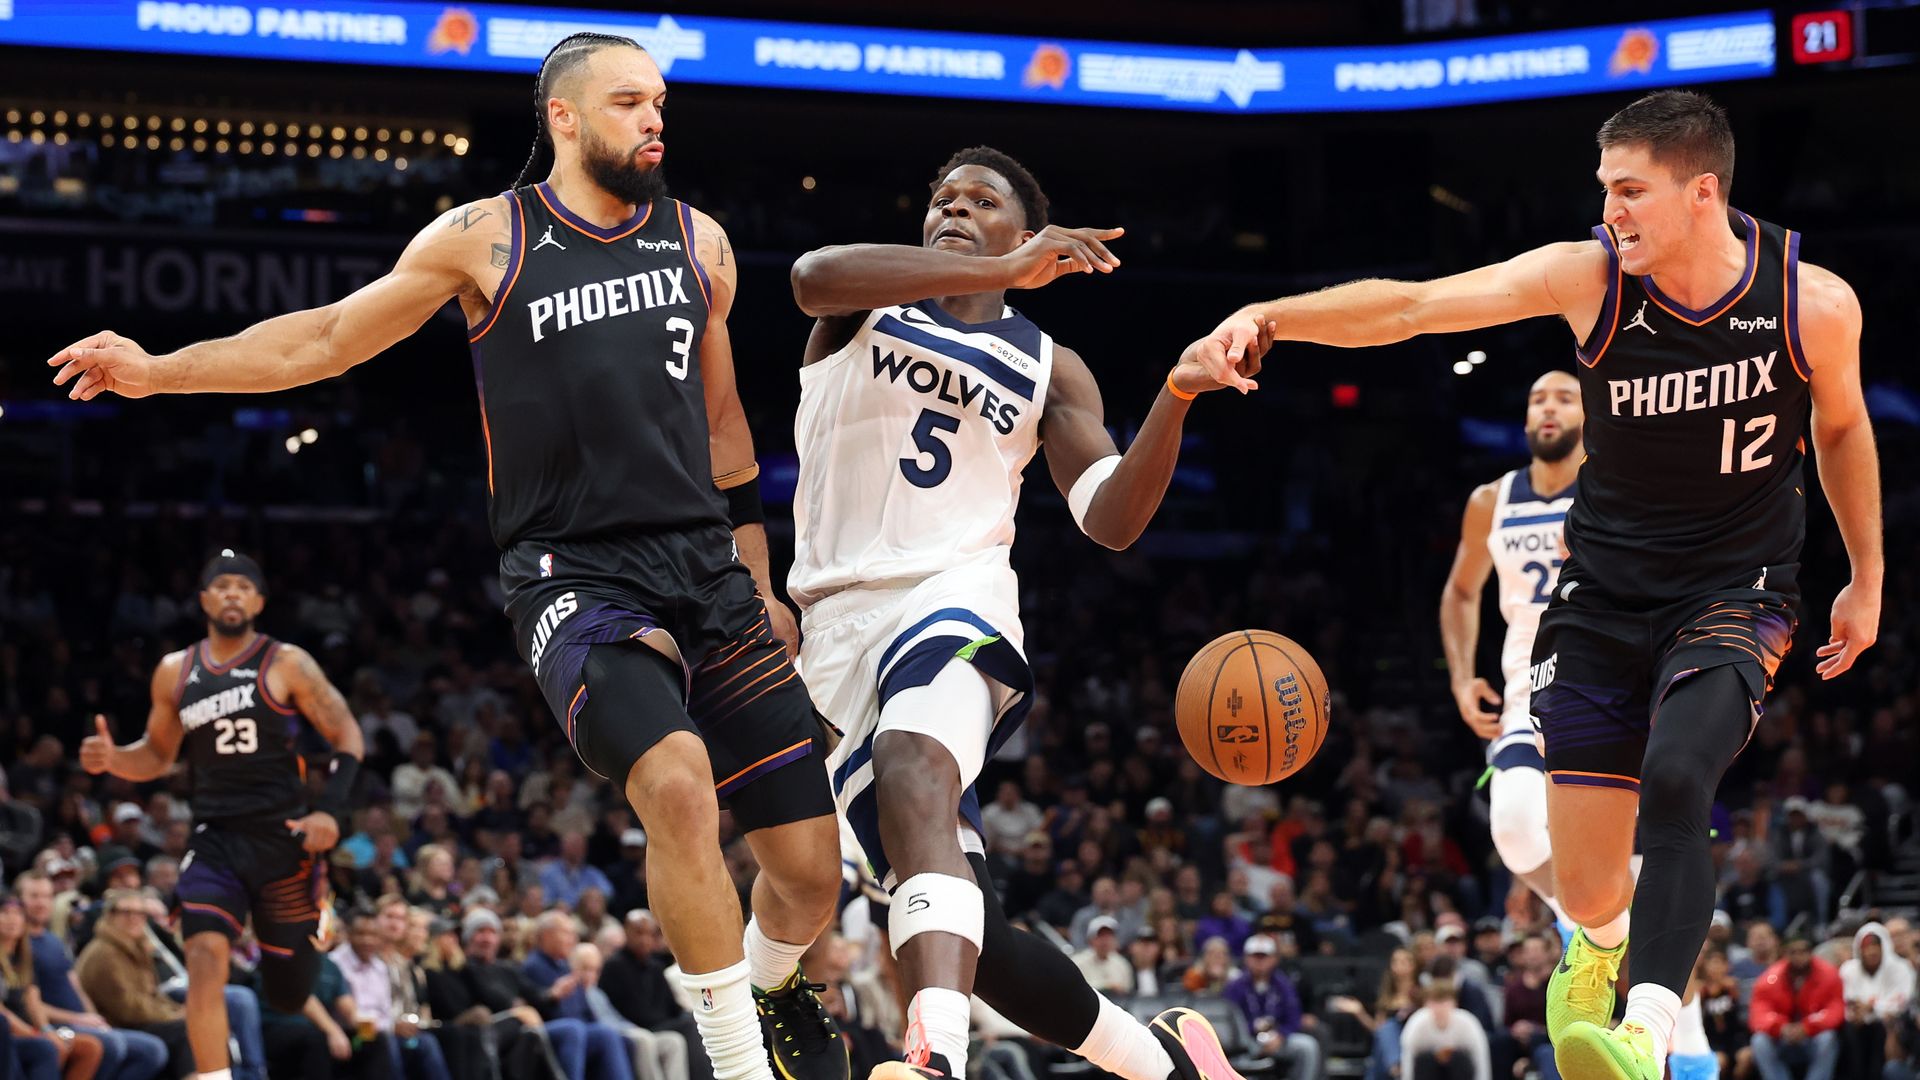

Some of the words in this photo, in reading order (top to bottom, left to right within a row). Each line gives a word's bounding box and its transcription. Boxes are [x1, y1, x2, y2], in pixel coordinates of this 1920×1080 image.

[137, 1, 252, 36] PROUD
[256, 7, 407, 45] PARTNER
[1804, 20, 1836, 53] 21
[754, 37, 862, 72] PROUD
[864, 43, 1006, 80] PARTNER
[1334, 58, 1444, 92] PROUD
[1447, 45, 1590, 86] PARTNER
[636, 238, 682, 252] PayPal
[86, 245, 382, 311] HORNIT
[527, 267, 691, 343] PHOENIX
[1729, 316, 1777, 333] PayPal
[665, 316, 695, 381] 3
[996, 345, 1029, 370] sezzle
[872, 345, 1020, 436] WOLVES
[1608, 350, 1778, 417] PHOENIX
[899, 408, 961, 489] 5
[1720, 414, 1777, 474] 12
[531, 591, 578, 677] SUNS
[179, 683, 256, 731] PHOENIX
[1273, 672, 1307, 772] Wilson
[214, 718, 258, 755] 23
[907, 892, 930, 914] 5
